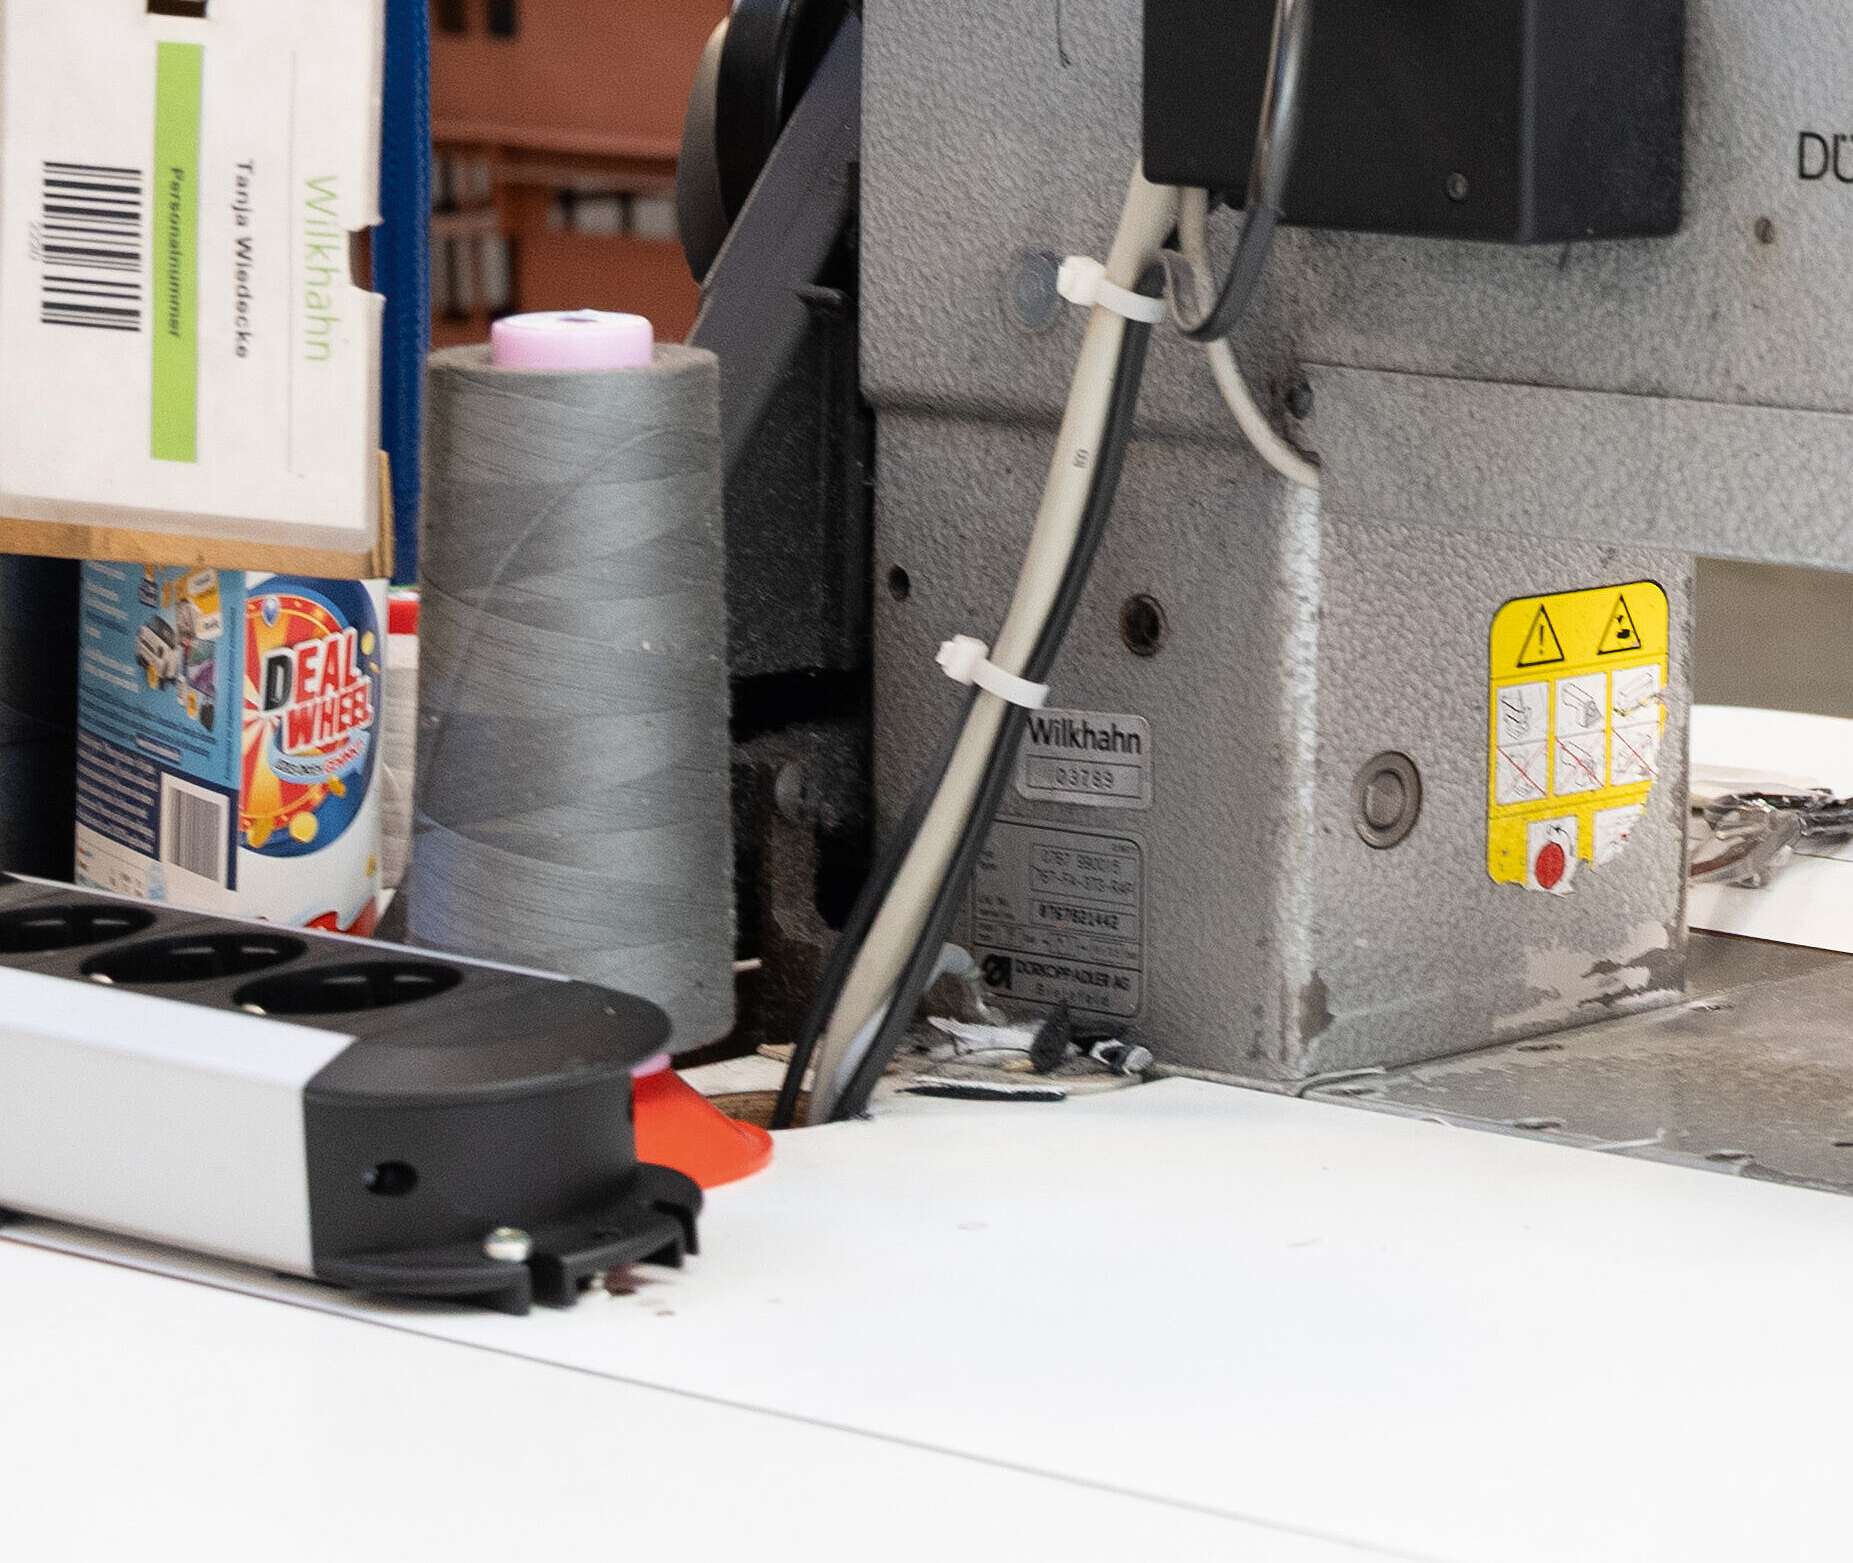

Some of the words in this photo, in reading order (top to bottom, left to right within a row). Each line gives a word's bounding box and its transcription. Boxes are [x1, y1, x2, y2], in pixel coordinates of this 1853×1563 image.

[231, 159, 254, 227] Tanja
[167, 167, 184, 337] Personalnummer
[235, 237, 254, 358] Wiedecke
[303, 174, 342, 362] Wilkhahn
[263, 631, 359, 712] DEAL
[1027, 716, 1141, 755] Wilkhahn
